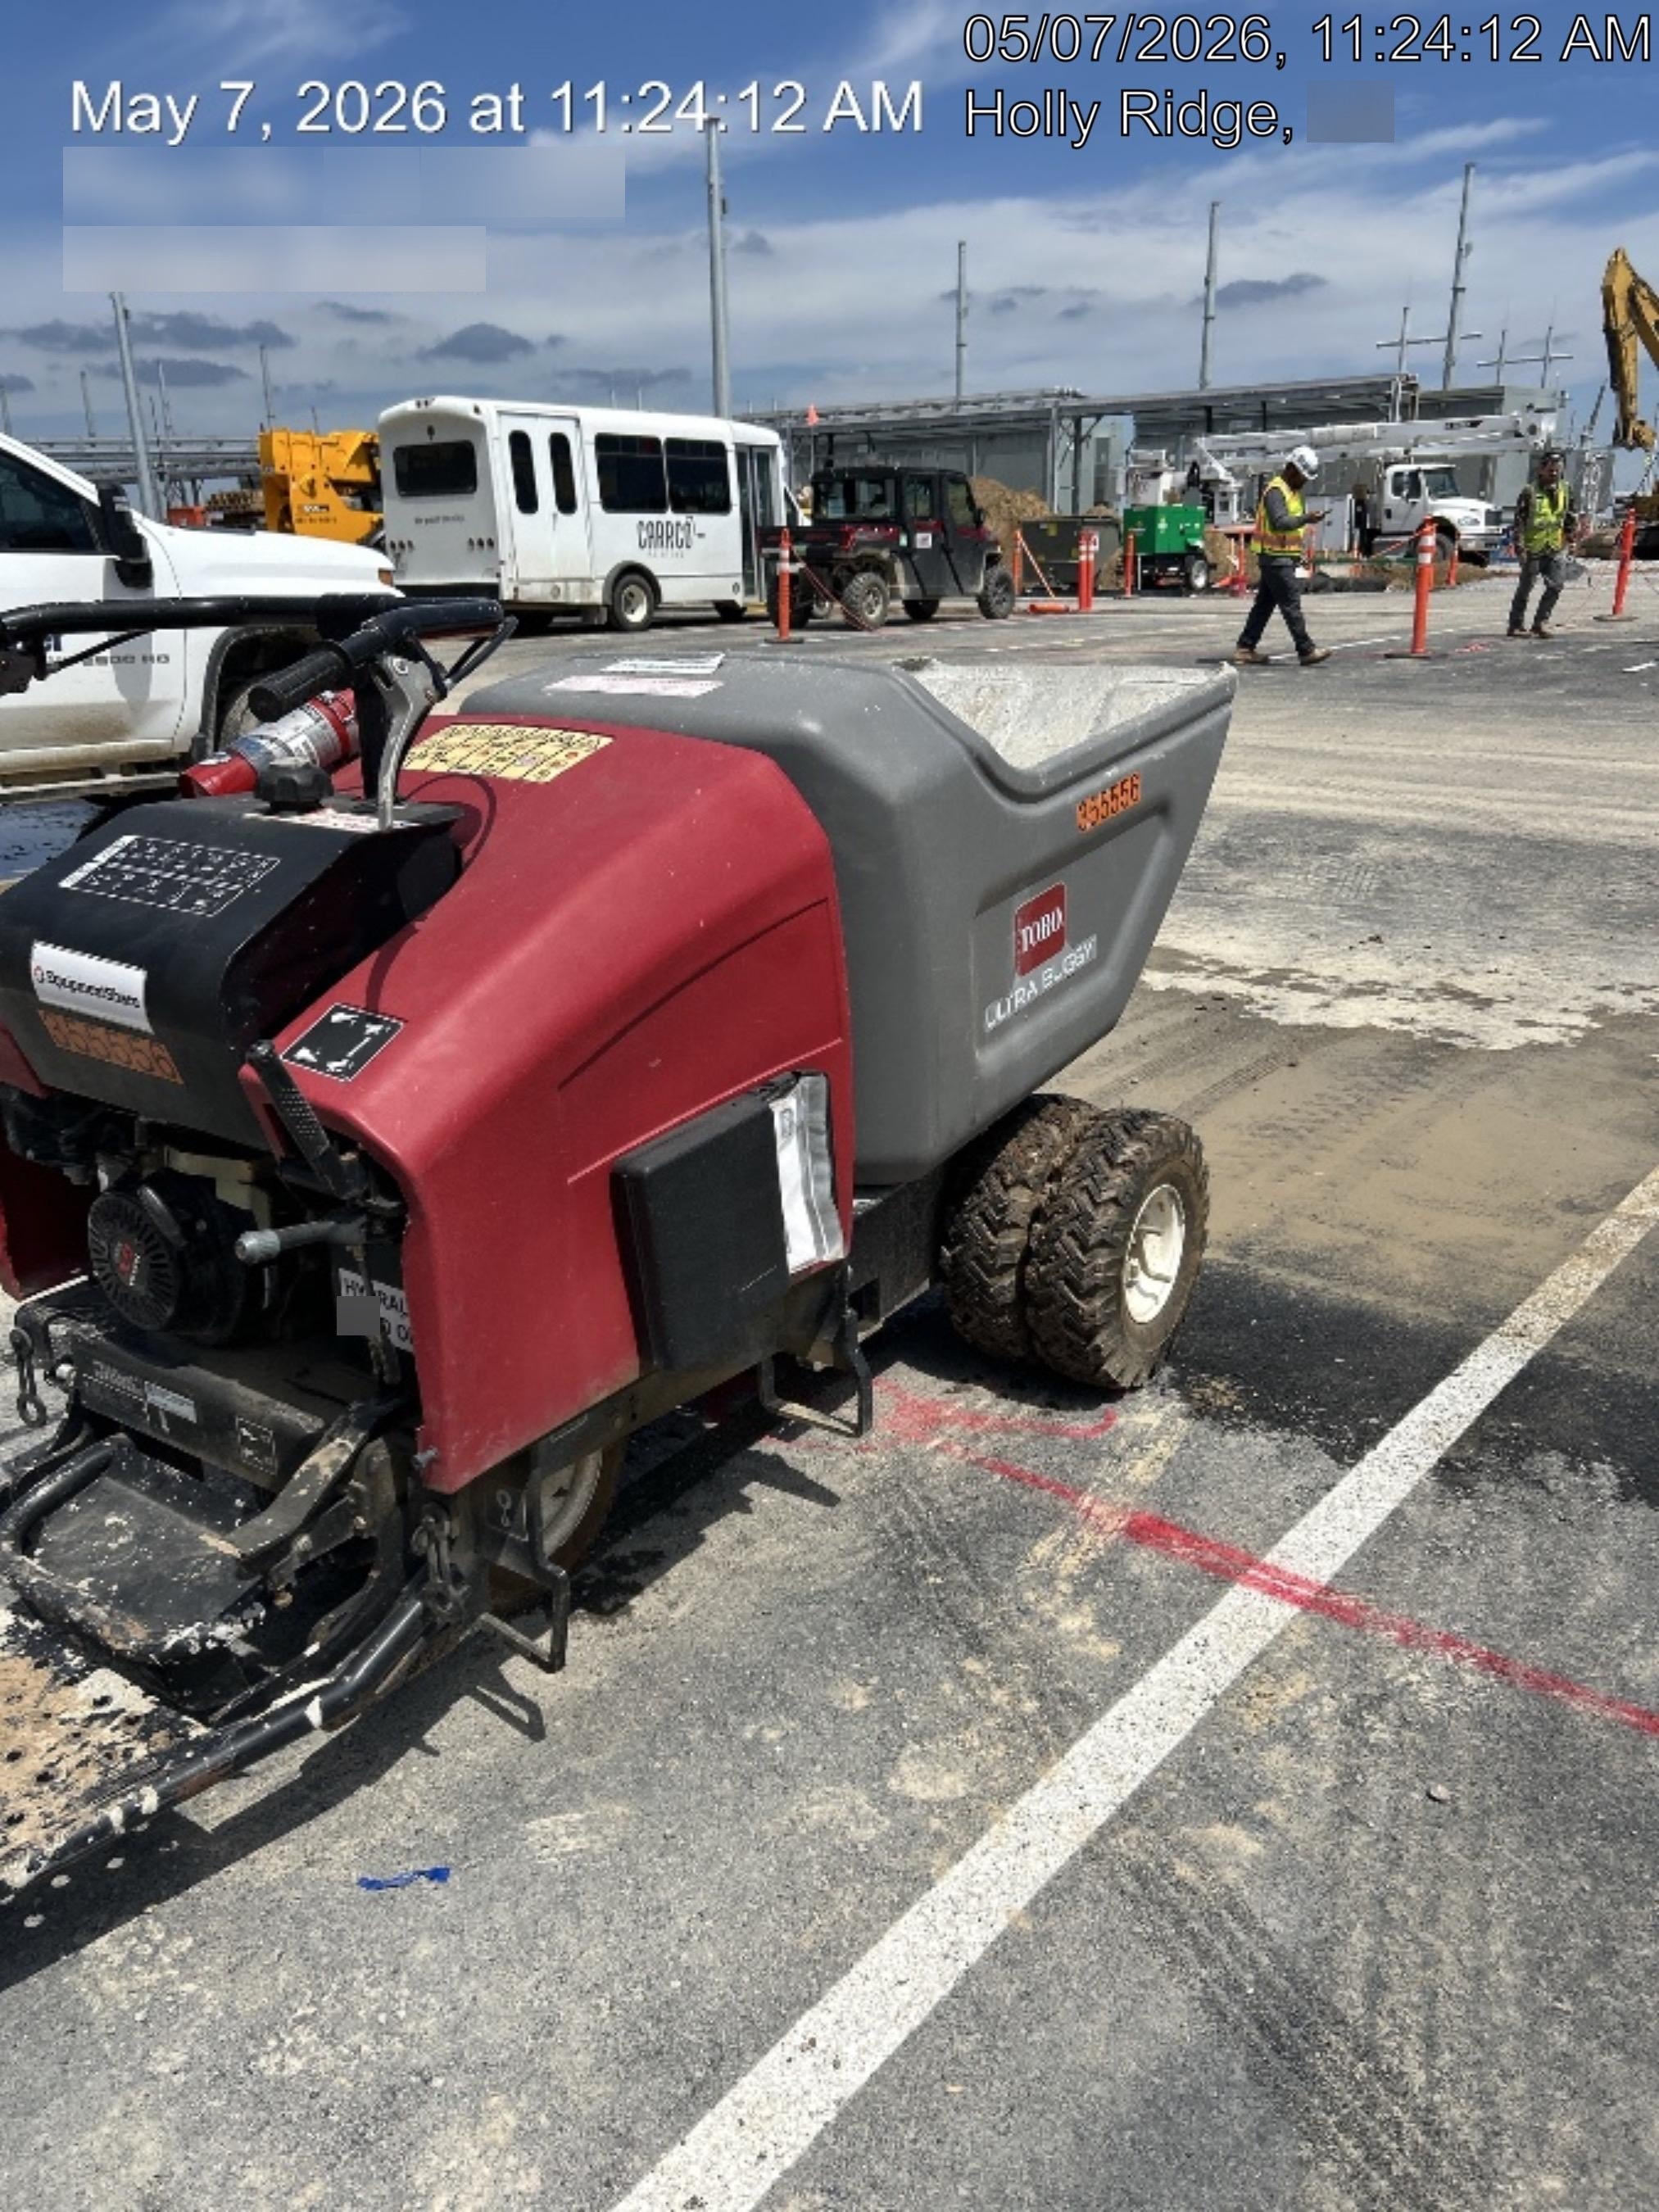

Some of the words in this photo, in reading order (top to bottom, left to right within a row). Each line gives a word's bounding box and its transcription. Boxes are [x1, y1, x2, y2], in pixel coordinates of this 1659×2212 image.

[1077, 773, 1140, 832] 355556
[1021, 906, 1064, 953] TORO
[985, 981, 1039, 1031] ULTRA
